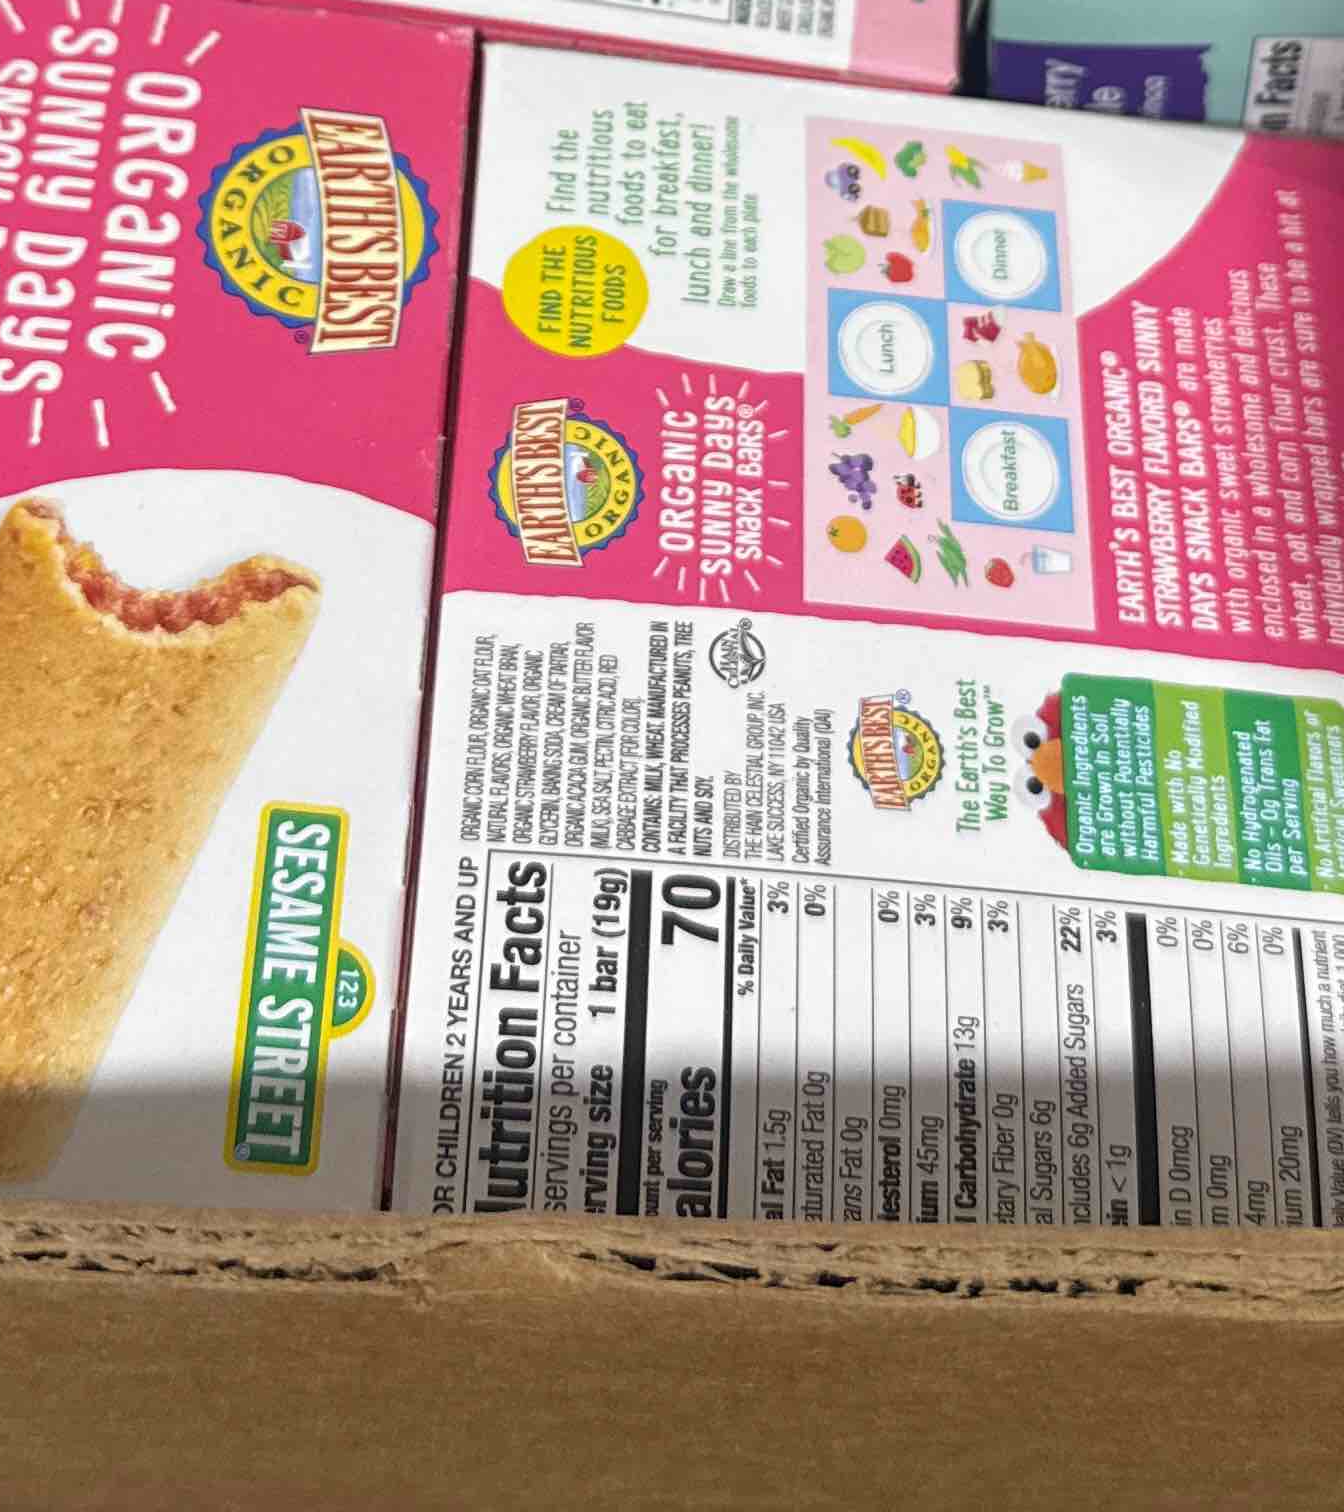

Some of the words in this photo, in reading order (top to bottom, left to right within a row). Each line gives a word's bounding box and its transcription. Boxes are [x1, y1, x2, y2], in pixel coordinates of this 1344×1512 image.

[549, 129, 578, 161] the
[623, 101, 648, 131] eat
[585, 107, 614, 216] nutritious
[621, 139, 647, 160] to
[650, 111, 684, 217] breakfast,
[686, 123, 715, 194] dinner!
[545, 171, 578, 214] Find
[614, 170, 646, 224] foods
[684, 200, 712, 239] and
[219, 144, 304, 310] ORGANIC
[648, 225, 678, 257] for
[992, 228, 1011, 282] Dinner
[540, 244, 567, 283] THE
[568, 235, 598, 349] NUTRITIOUS
[681, 247, 711, 305] lunch
[318, 254, 398, 344] BEST
[537, 299, 564, 334] FIND
[602, 264, 627, 325] FOODS
[881, 321, 898, 375] Lunch
[1132, 301, 1162, 374] SUNNY
[516, 403, 565, 460] BEST
[1137, 380, 1171, 476] FLAVORED
[575, 426, 630, 538] ORGANIC
[1002, 428, 1020, 512] Breakfast
[1109, 464, 1138, 520] BEST
[1146, 483, 1183, 628] STRAWBERRY
[1182, 488, 1213, 562] SNACK
[1108, 527, 1146, 625] EARTH'S
[1188, 570, 1220, 632] DAYS
[651, 620, 668, 632] IN
[647, 634, 668, 718] MANUFACTURED
[954, 679, 976, 719] Best
[644, 763, 667, 792] MILK,
[955, 726, 979, 793] Earth's
[982, 755, 1006, 773] To
[642, 793, 663, 854] CONTAINS:
[956, 799, 981, 832] The
[984, 781, 1010, 821] Way
[261, 819, 332, 985] SESAME
[457, 855, 481, 889] UP
[452, 894, 476, 945] AND
[490, 861, 549, 993] Facts
[592, 866, 630, 941] (19g)
[660, 873, 722, 946] 70
[1060, 907, 1080, 952] 22%
[336, 967, 360, 1010] 123
[449, 947, 474, 1027] YEARS
[552, 927, 582, 1046] container
[588, 945, 620, 995] bar
[955, 1016, 978, 1051] 13g
[1065, 984, 1089, 1050] Sugars
[245, 993, 314, 1160] STREET
[583, 1063, 614, 1123] size
[1066, 1056, 1087, 1117] Added
[435, 1052, 465, 1179] CHILDREN
[666, 1066, 716, 1219] alories
[954, 1058, 980, 1209] Carbohydrate
